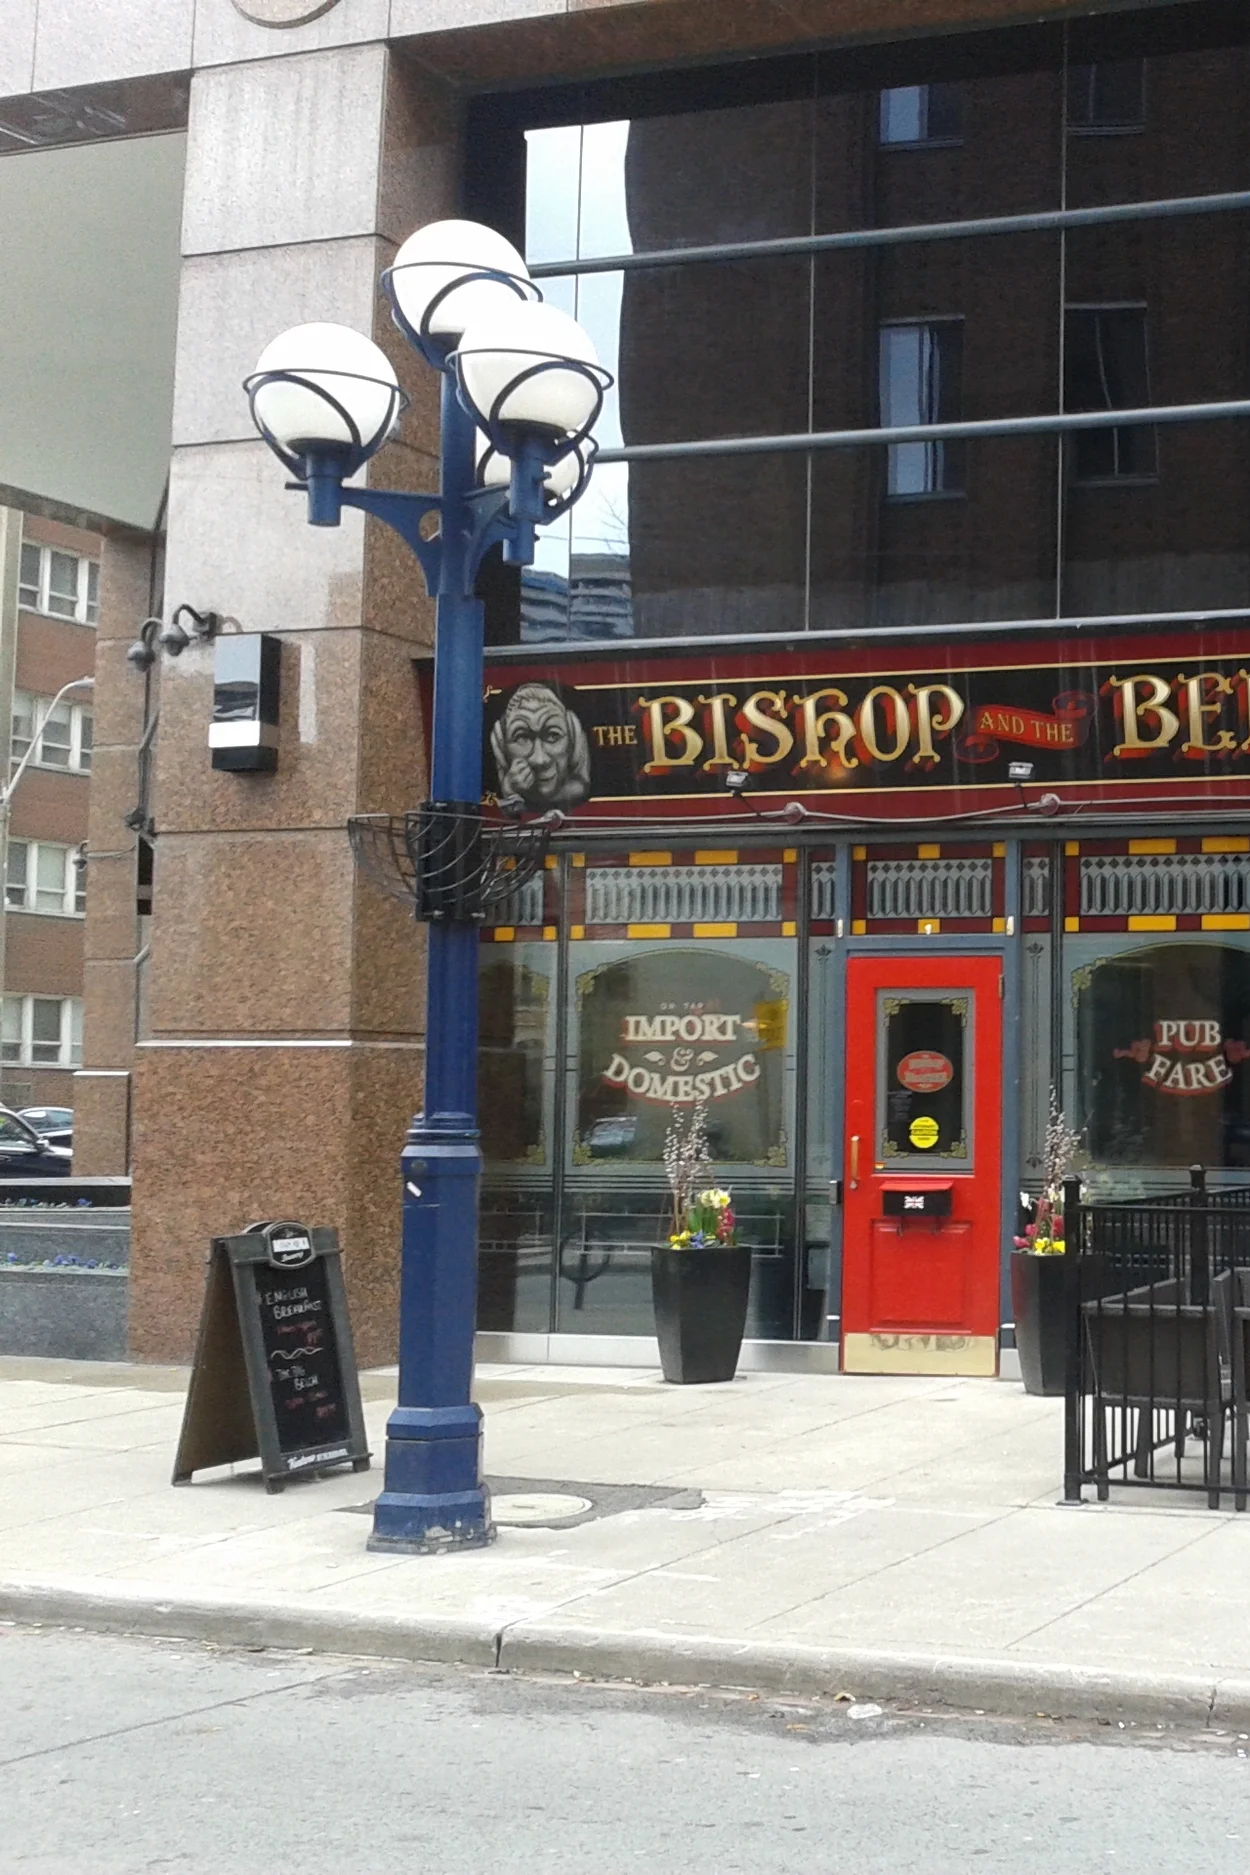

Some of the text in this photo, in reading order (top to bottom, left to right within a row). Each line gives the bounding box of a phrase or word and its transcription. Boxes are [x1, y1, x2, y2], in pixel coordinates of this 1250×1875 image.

[592, 725, 638, 746] THE
[638, 683, 965, 773] BISHOP
[980, 712, 1025, 735] AND
[1030, 720, 1074, 742] THE
[624, 1014, 741, 1041] IMPORT
[1156, 1020, 1221, 1046] PUB
[670, 1046, 694, 1071] &
[1145, 1054, 1233, 1090] FARE
[602, 1053, 761, 1102] DOMESTIC
